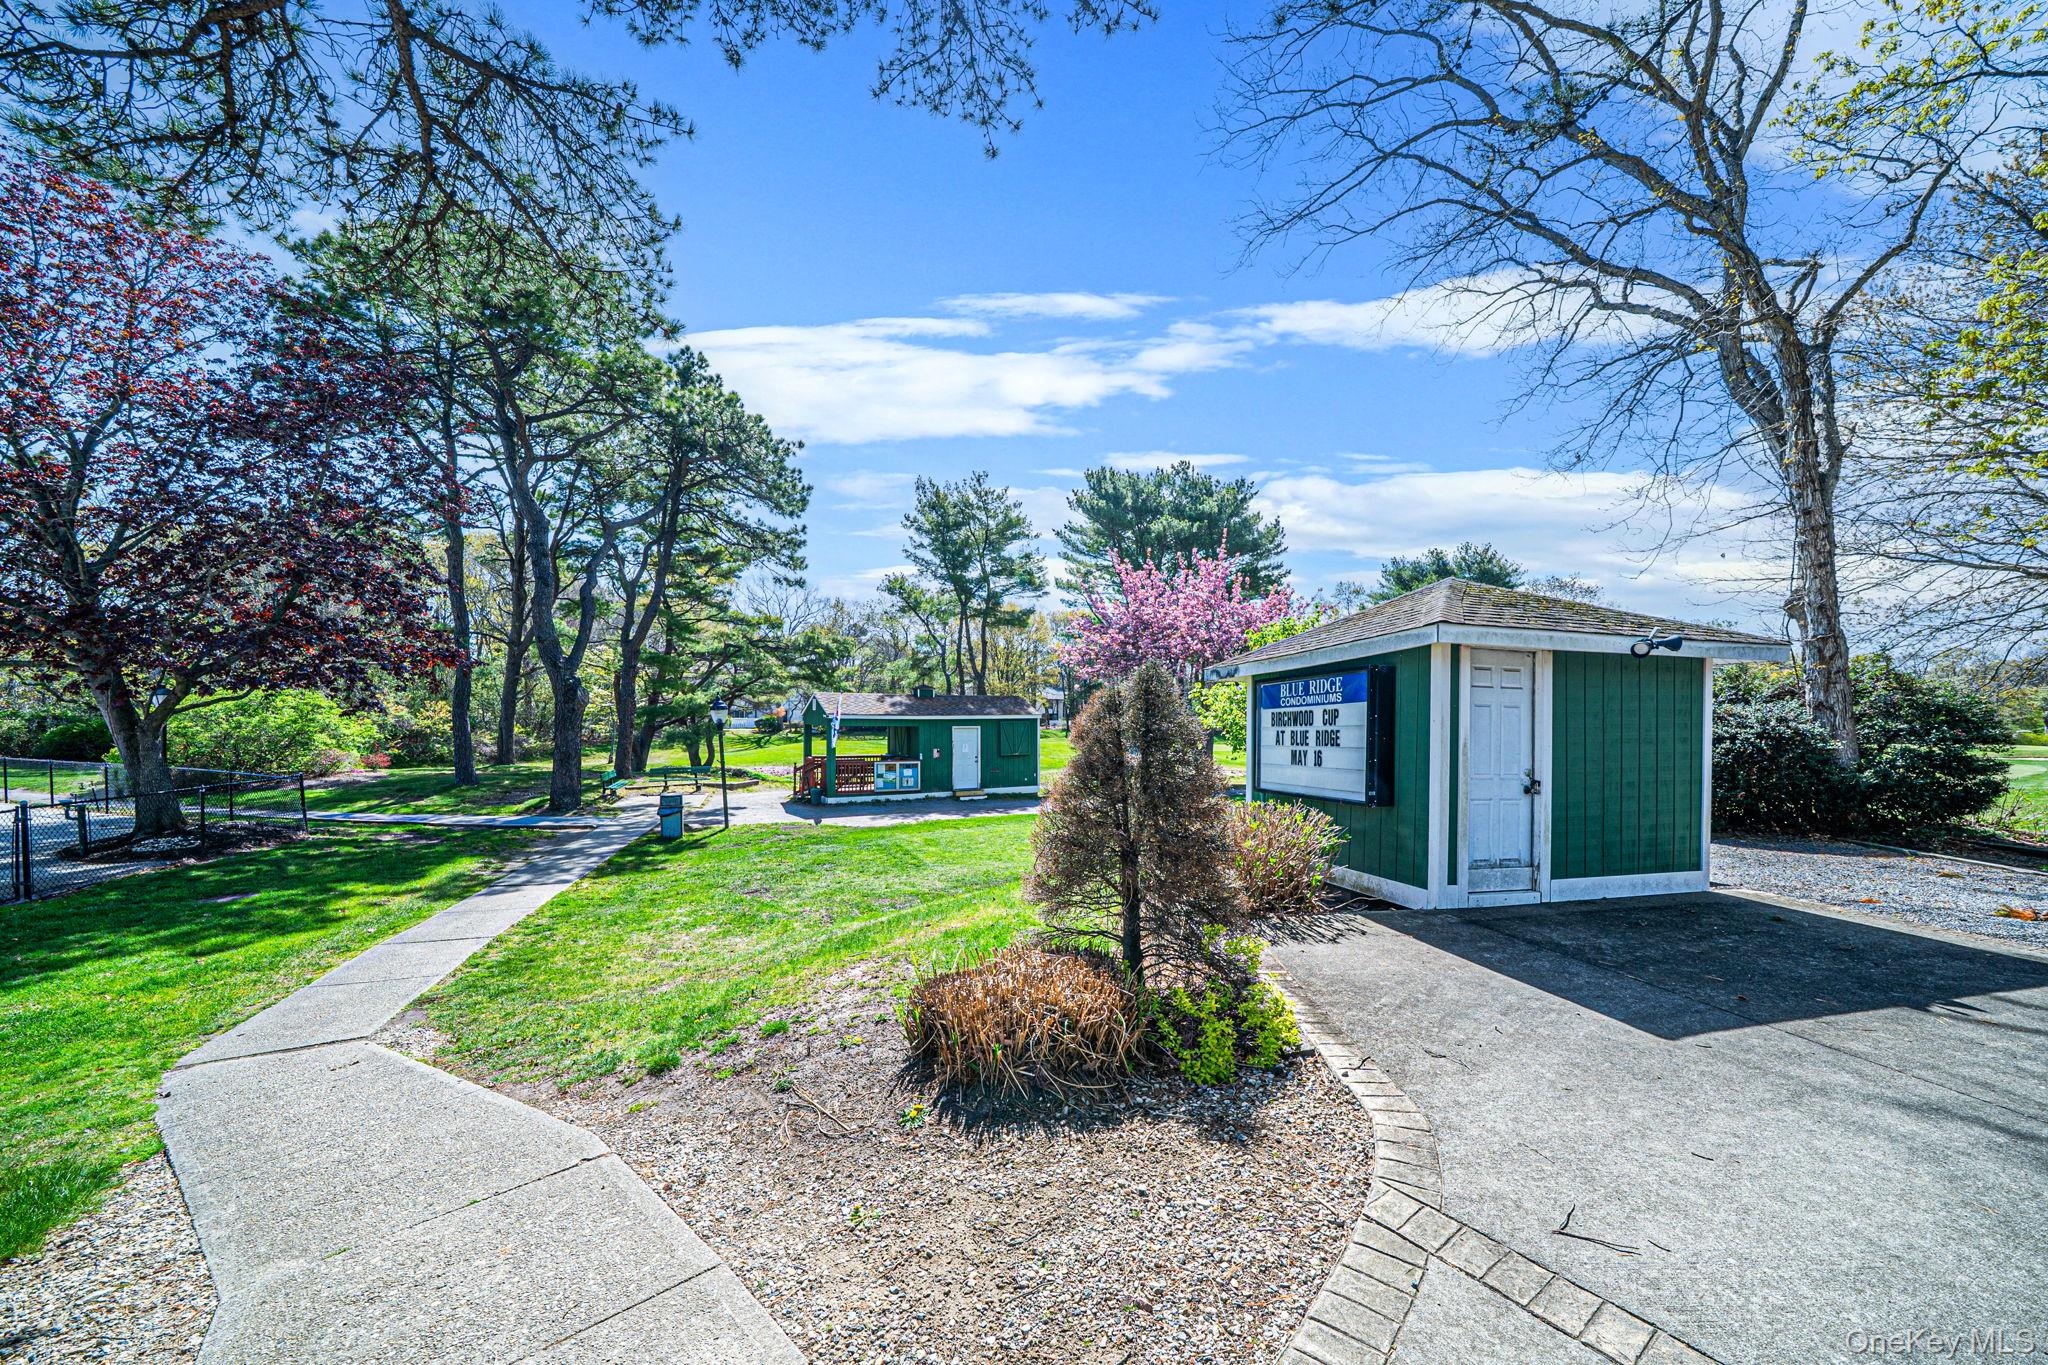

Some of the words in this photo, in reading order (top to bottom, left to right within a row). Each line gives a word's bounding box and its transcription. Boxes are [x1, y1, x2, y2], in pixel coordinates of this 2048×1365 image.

[1280, 681, 1305, 698] BLUE
[1309, 677, 1343, 695] RIDGE
[1280, 692, 1342, 707] CONDOMINIUMS
[1271, 710, 1314, 727] BIRCHWOOD
[1322, 709, 1340, 726] CUP
[1275, 731, 1285, 746] AT
[1290, 730, 1309, 747] BLUE
[1315, 730, 1341, 747] RIDGE
[1290, 750, 1309, 766] MAY
[1313, 750, 1323, 767] 16
